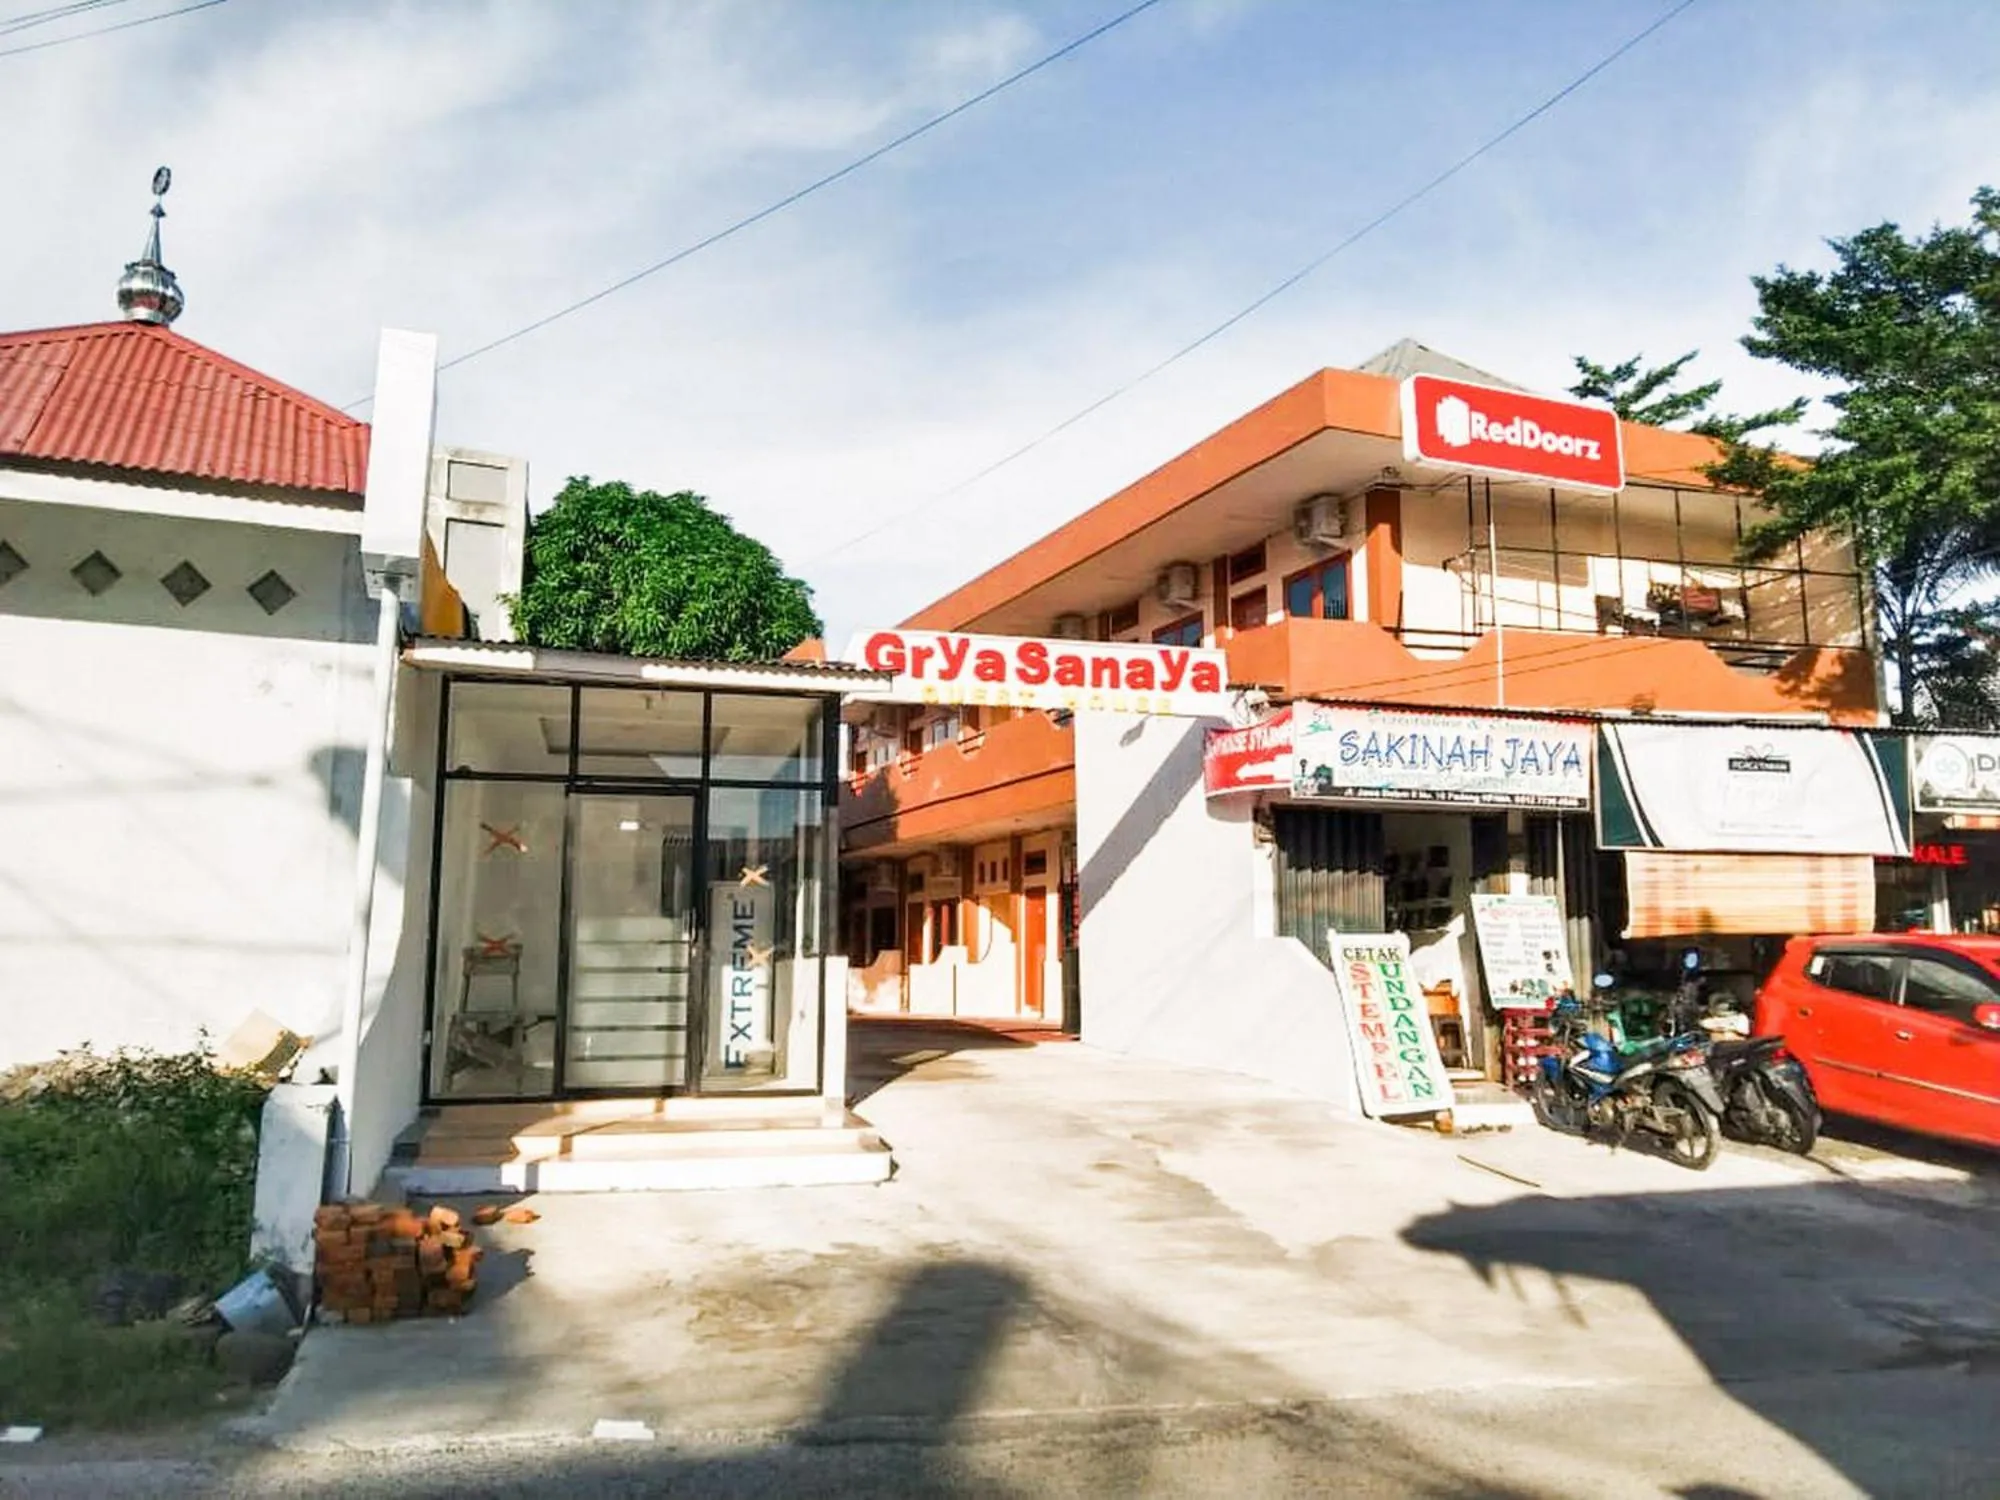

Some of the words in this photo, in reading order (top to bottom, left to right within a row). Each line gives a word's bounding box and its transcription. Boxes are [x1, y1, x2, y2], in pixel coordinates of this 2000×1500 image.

[1470, 411, 1601, 461] RedDoorz
[1338, 729, 1493, 772] SAKINAH
[1500, 737, 1584, 778] JAYA
[724, 899, 756, 1070] EXTREME
[1343, 947, 1401, 962] CETAK
[1350, 963, 1401, 1100] STEMPEL
[1379, 963, 1433, 1098] UNDANGAN
